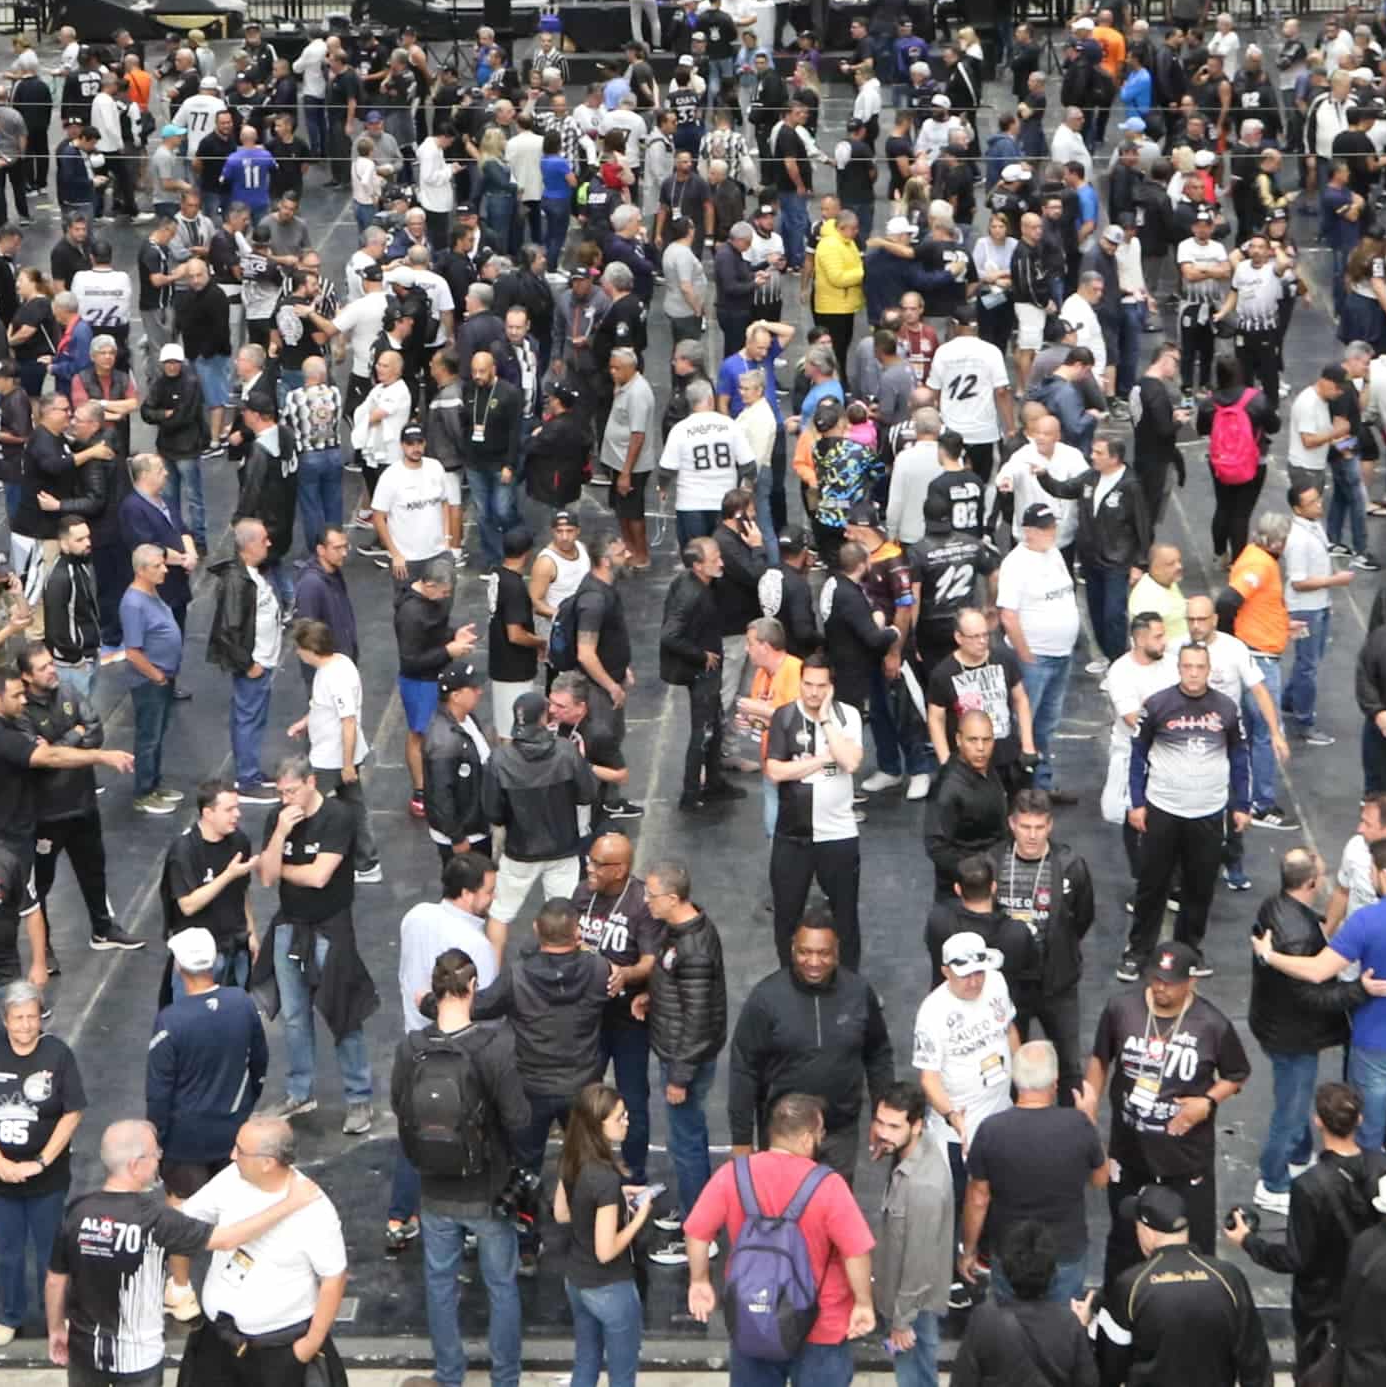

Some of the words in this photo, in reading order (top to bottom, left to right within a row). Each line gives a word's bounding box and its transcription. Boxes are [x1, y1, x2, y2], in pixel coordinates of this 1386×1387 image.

[244, 165, 261, 190] 11
[947, 373, 979, 402] 12
[692, 441, 731, 471] 88
[934, 563, 975, 605] 12
[601, 921, 629, 953] 70
[1164, 1043, 1198, 1082] 70
[113, 1222, 142, 1253] 70
